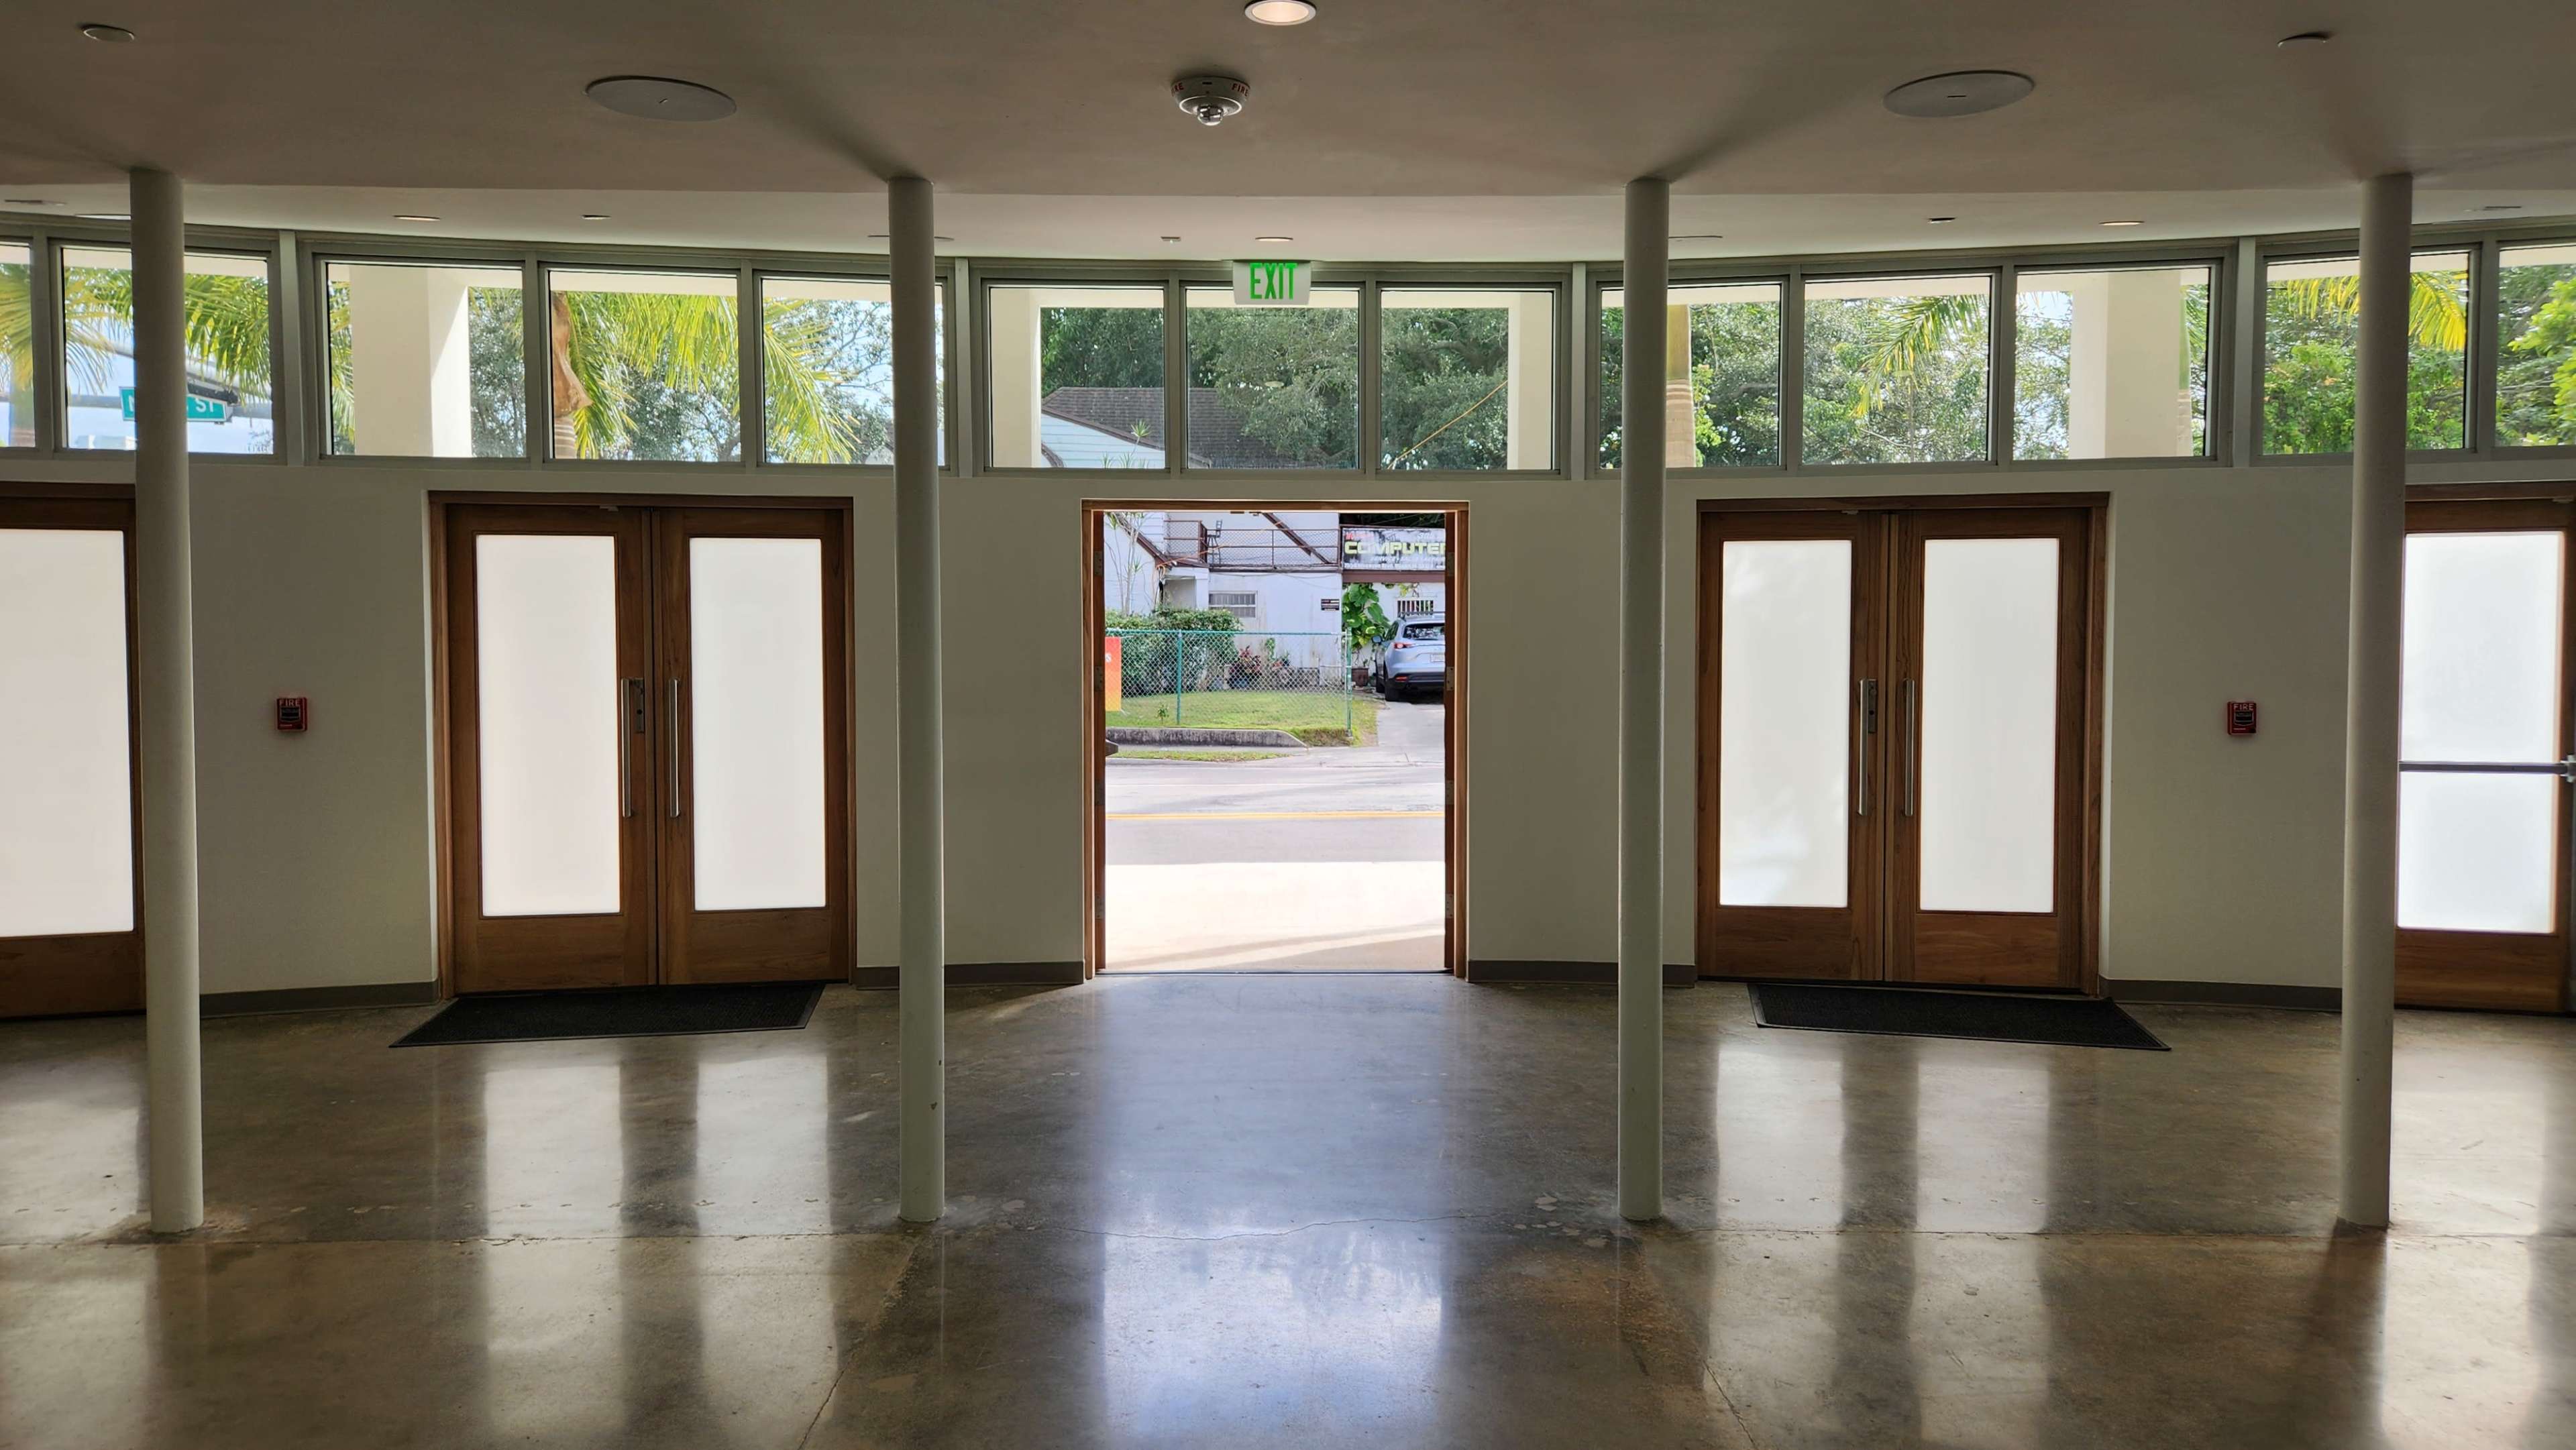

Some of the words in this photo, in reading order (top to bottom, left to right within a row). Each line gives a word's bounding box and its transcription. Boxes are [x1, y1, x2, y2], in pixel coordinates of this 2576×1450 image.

[1250, 262, 1297, 300] EXIT
[195, 398, 215, 412] ST
[279, 699, 301, 707] FIRE
[2234, 703, 2254, 711] FIRE
